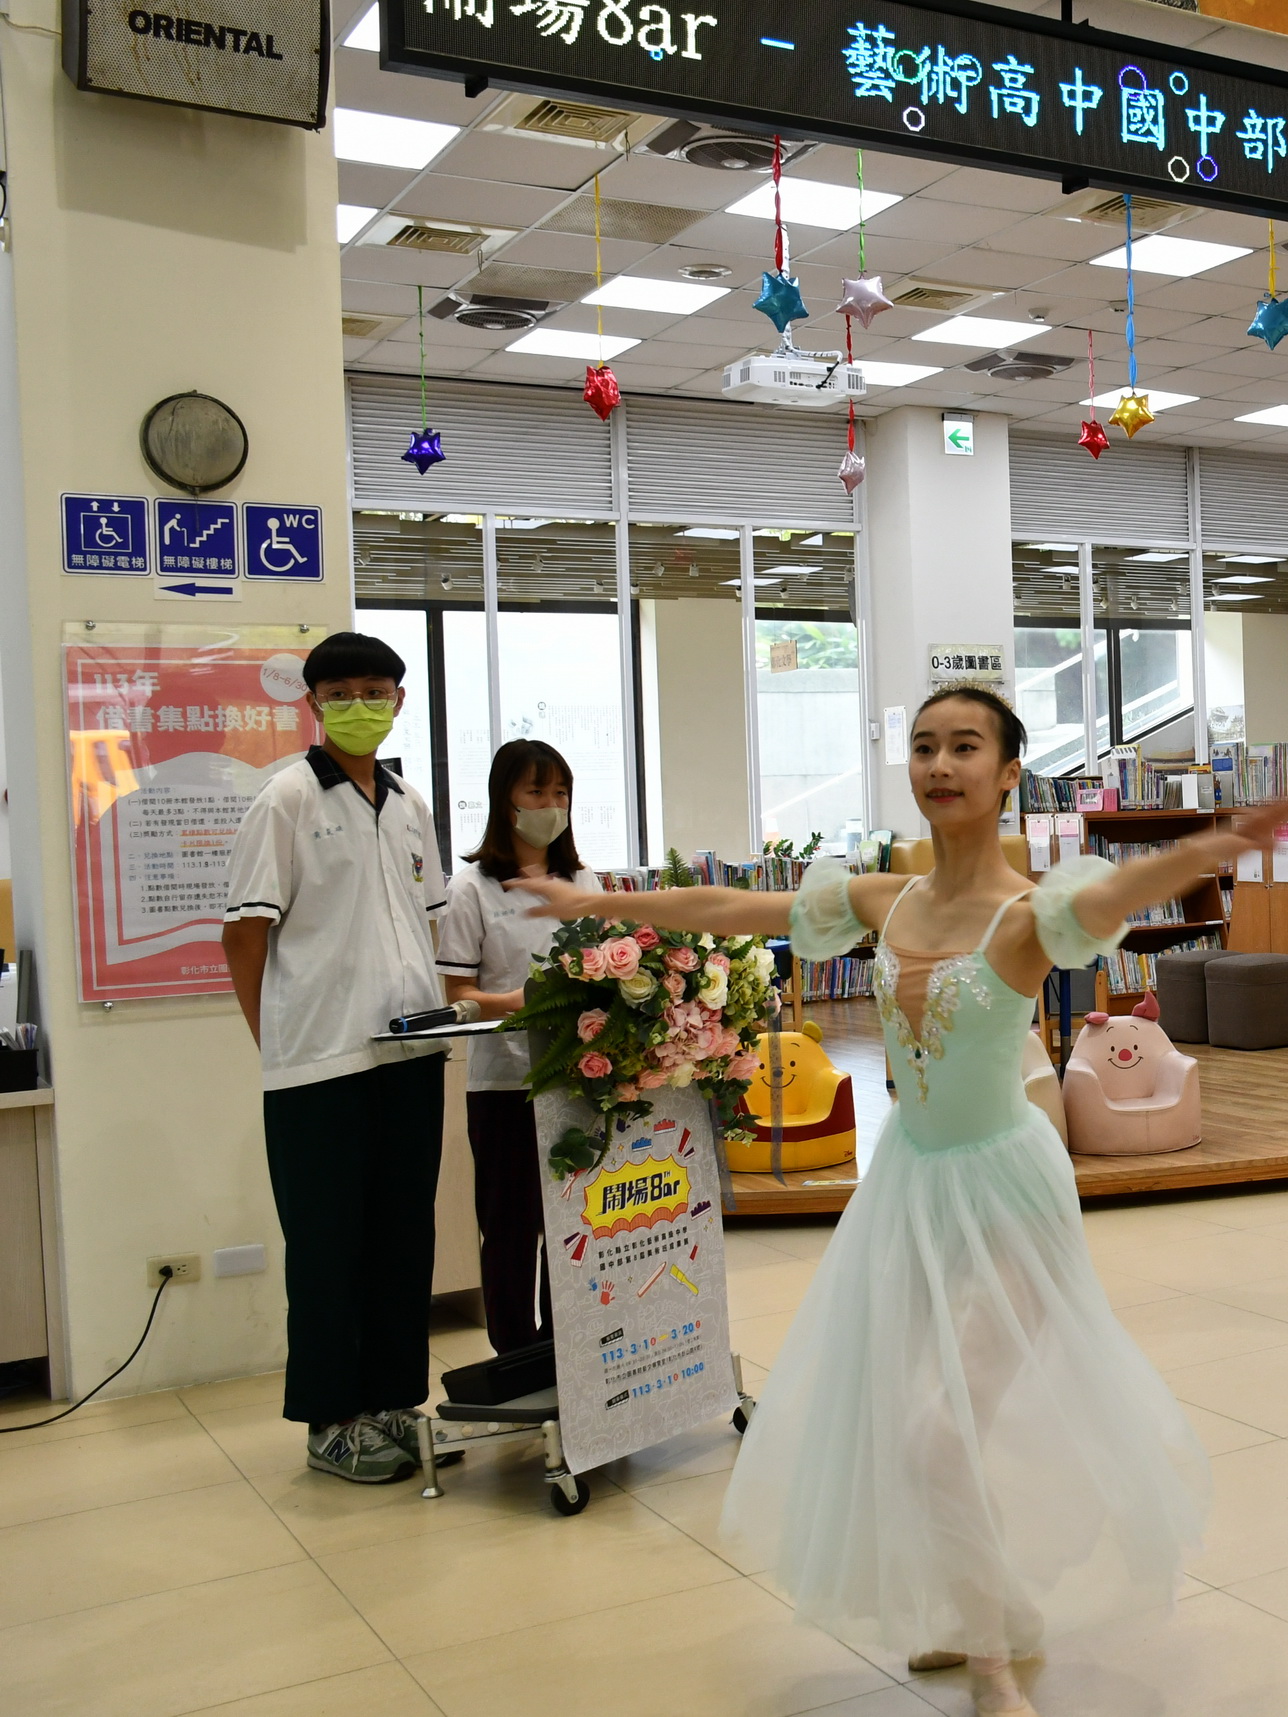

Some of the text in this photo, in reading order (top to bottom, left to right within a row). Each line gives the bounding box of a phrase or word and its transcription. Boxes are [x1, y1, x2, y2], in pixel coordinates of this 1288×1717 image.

[128, 10, 283, 60] ORIENTAL
[283, 513, 316, 529] WC
[71, 554, 145, 569] 無障礙電梯
[163, 555, 233, 570] 無障礙樓梯
[931, 654, 1002, 671] 0-3歲圖書區
[94, 669, 161, 697] 113年
[96, 705, 299, 733] 借書集點換好書
[181, 964, 231, 975] 彰化市立圖
[327, 1438, 352, 1465] N
